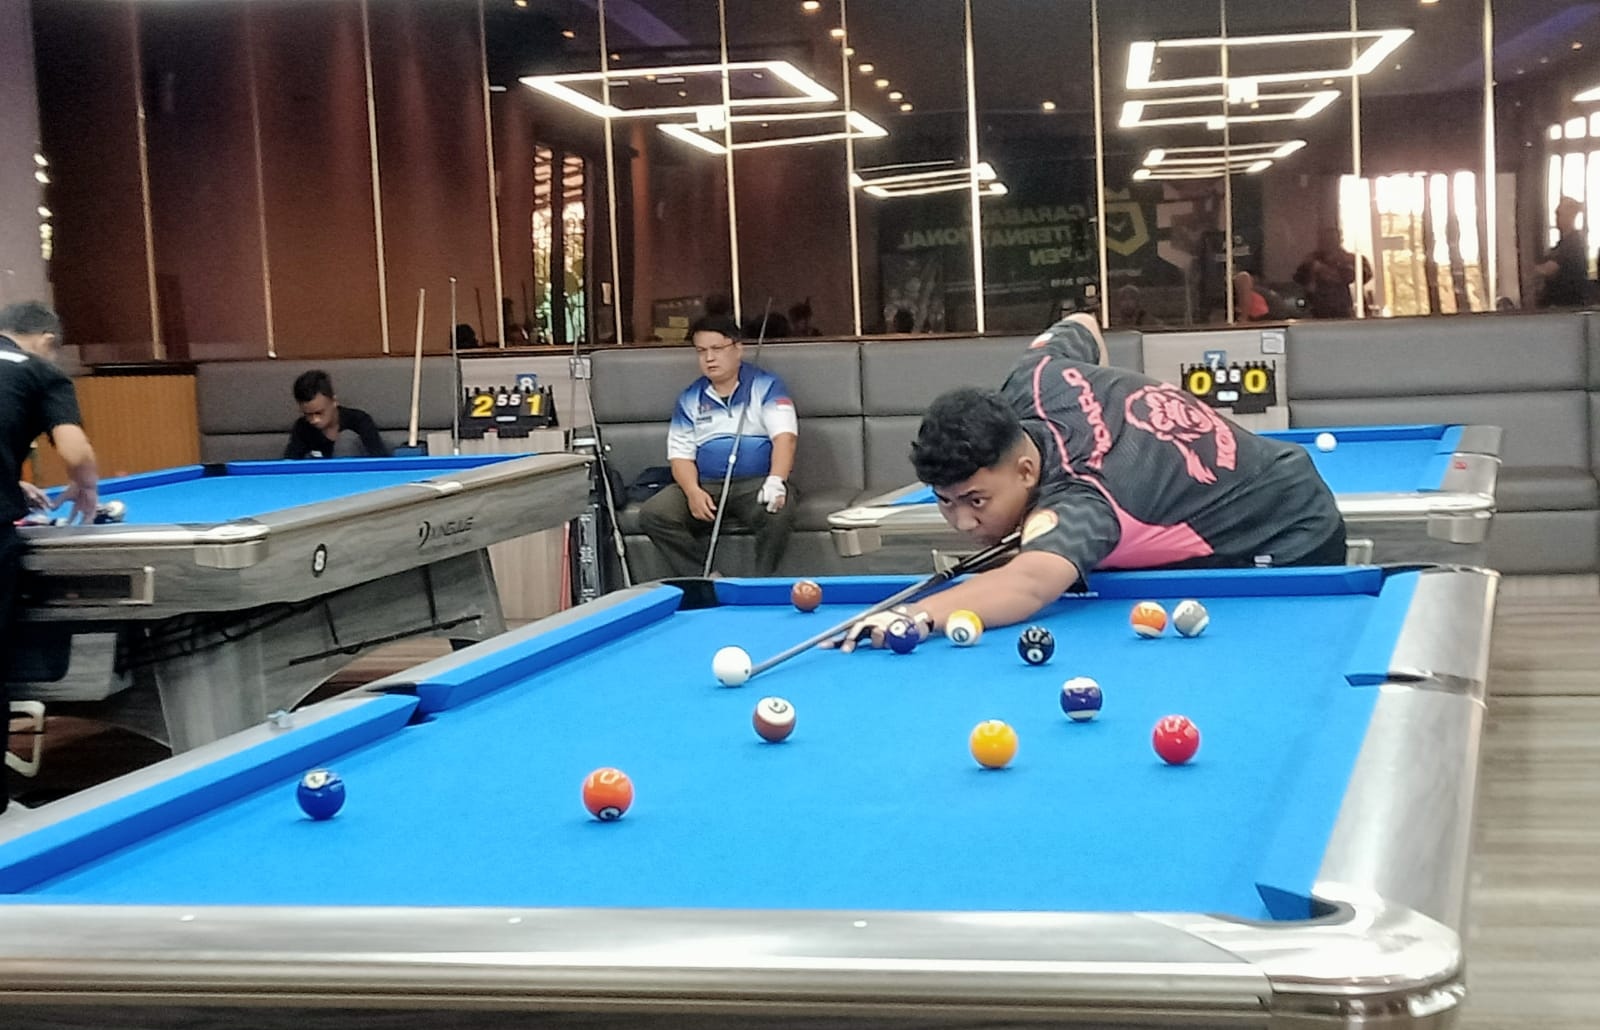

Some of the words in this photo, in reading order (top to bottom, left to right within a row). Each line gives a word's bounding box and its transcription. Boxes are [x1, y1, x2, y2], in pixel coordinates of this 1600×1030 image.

[1207, 353, 1221, 371] 7
[1190, 371, 1211, 395] 0
[1244, 369, 1267, 393] 0
[471, 395, 494, 417] 2
[527, 394, 541, 415] 1
